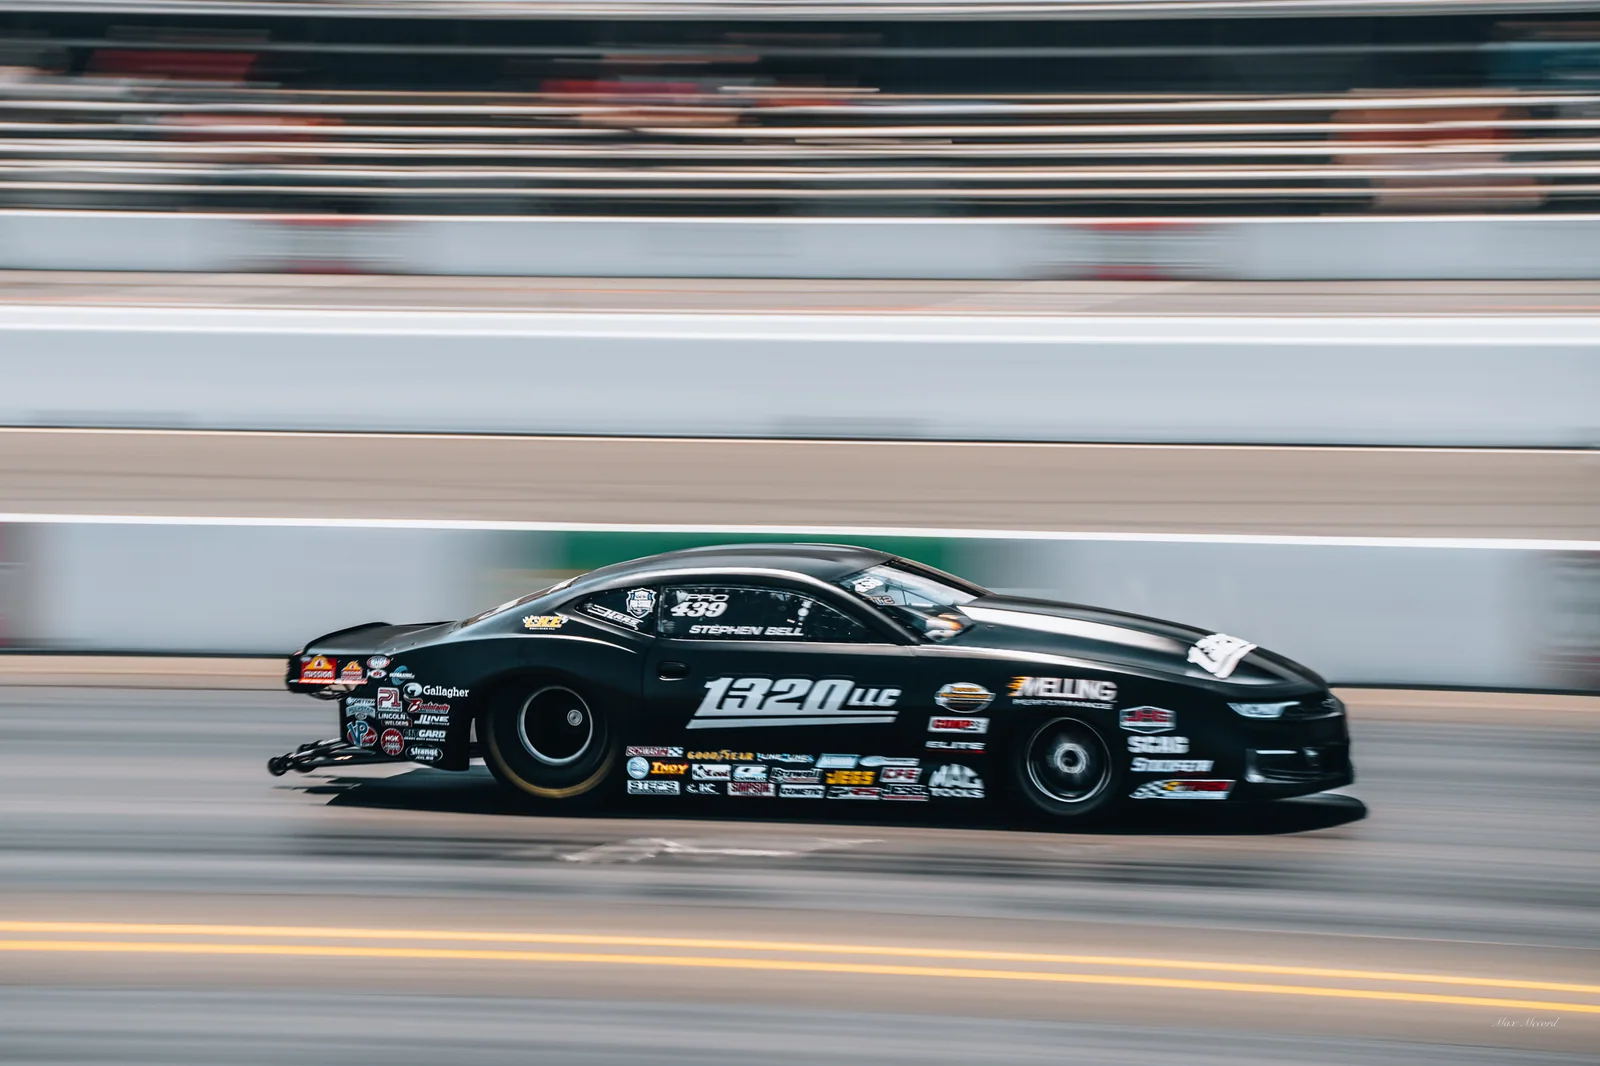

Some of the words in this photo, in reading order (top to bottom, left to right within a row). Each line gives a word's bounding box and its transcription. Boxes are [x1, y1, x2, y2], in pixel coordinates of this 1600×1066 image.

[684, 594, 729, 602] PRO
[670, 602, 728, 617] 439
[689, 625, 763, 635] STEPHEN
[764, 626, 804, 636] BELL
[423, 685, 469, 698] Gallagher
[1017, 677, 1118, 701] MELLING
[378, 689, 401, 707] P1
[694, 677, 855, 716] 1320
[1012, 699, 1114, 710] PERFORMANCE
[347, 720, 369, 747] VP
[928, 764, 985, 789] MAC
[731, 782, 772, 792] SIMPSON
[930, 788, 986, 798] TOOLS
